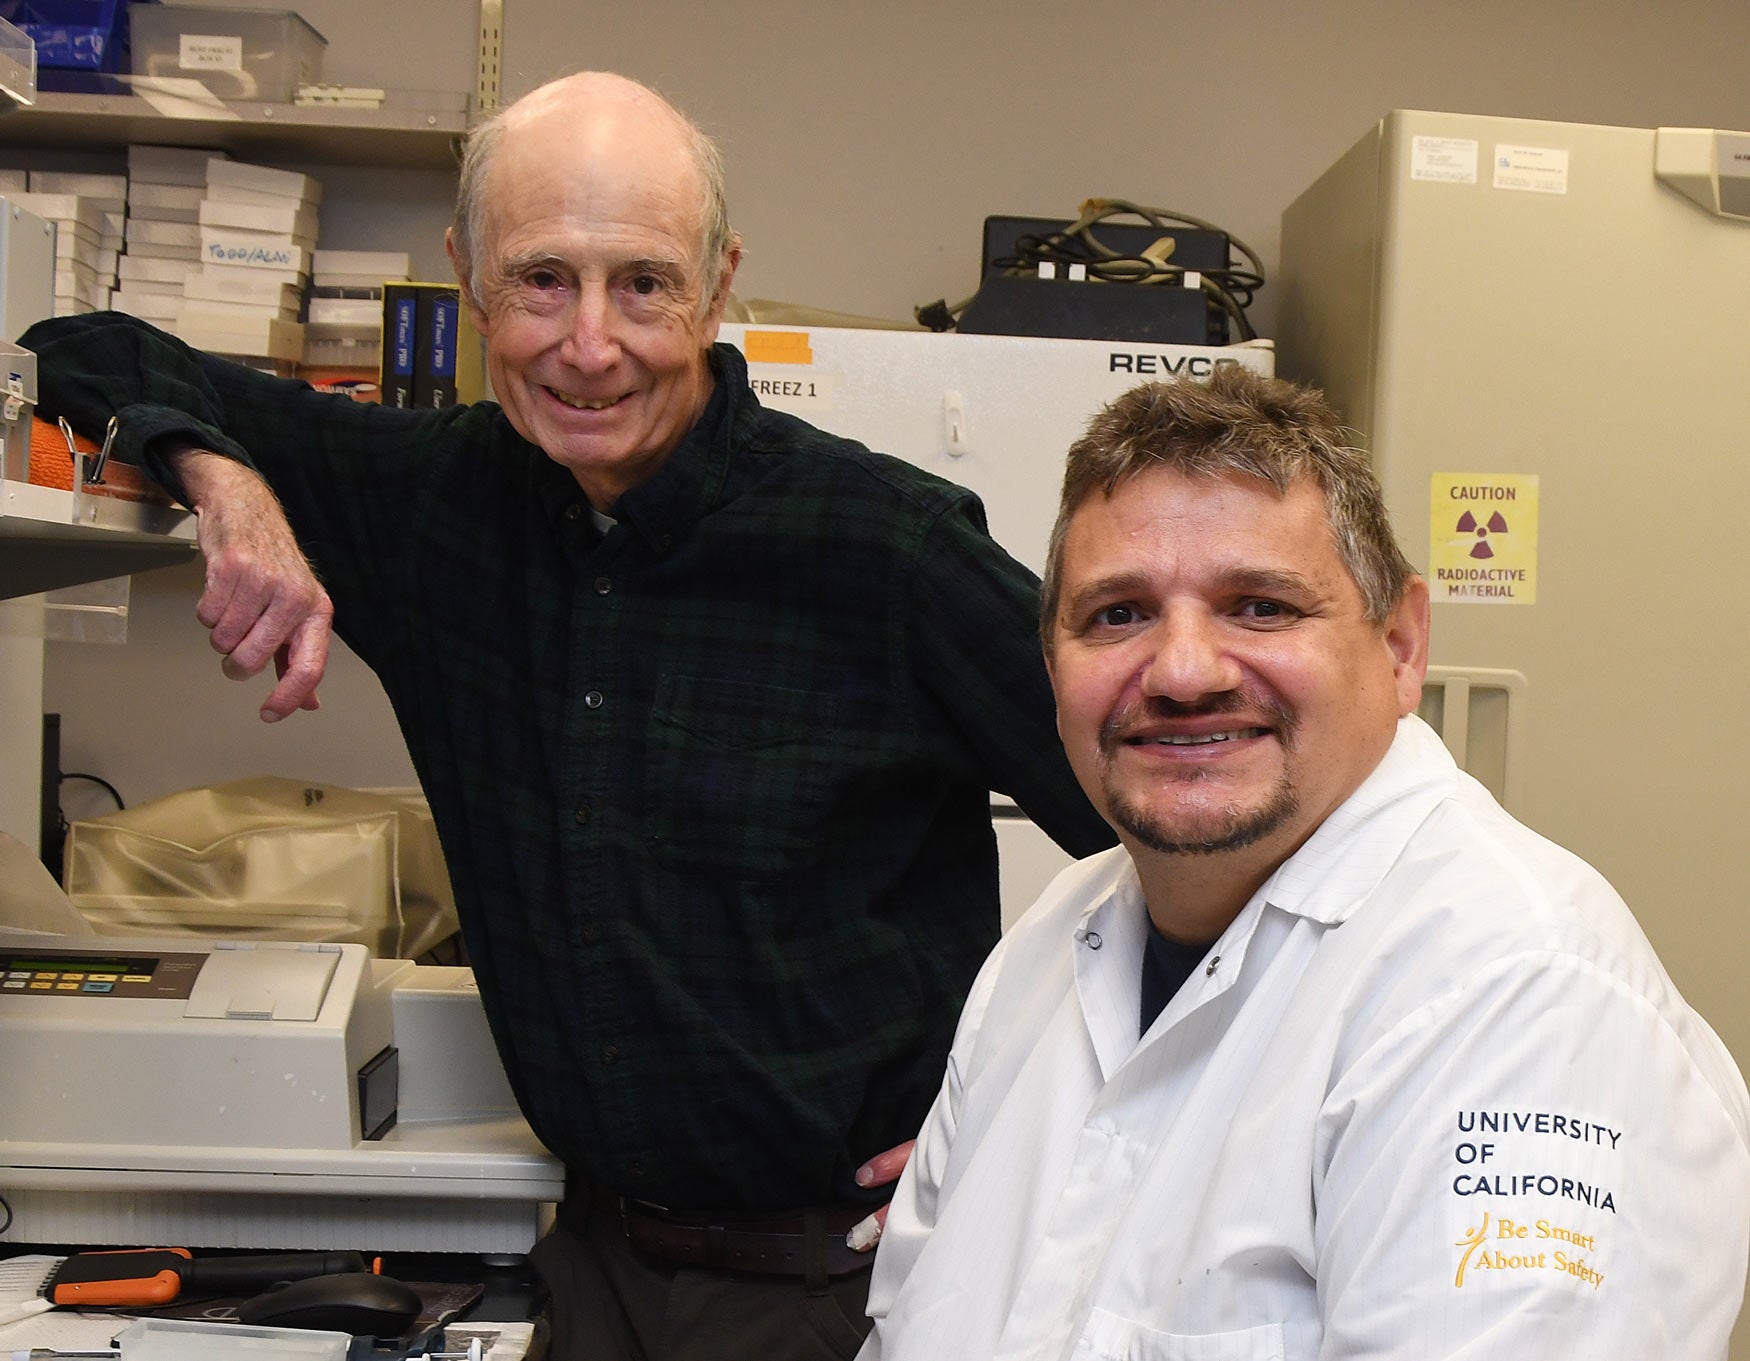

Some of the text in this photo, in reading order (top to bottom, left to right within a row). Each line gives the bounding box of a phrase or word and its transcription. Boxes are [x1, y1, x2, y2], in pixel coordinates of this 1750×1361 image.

[398, 348, 408, 368] PRO
[434, 349, 444, 369] PRO
[751, 379, 817, 397] FREEZ 1
[1450, 486, 1516, 501] CAUTION
[1437, 568, 1526, 581] RADIOACTIVE
[1448, 584, 1515, 598] MATERIAL
[1457, 1111, 1622, 1150] UNIVERSITY
[1455, 1143, 1495, 1165] OF
[1453, 1174, 1617, 1214] CALIFORNIA
[1497, 1218, 1595, 1252] Be Smart
[1474, 1250, 1605, 1291] About Safety
